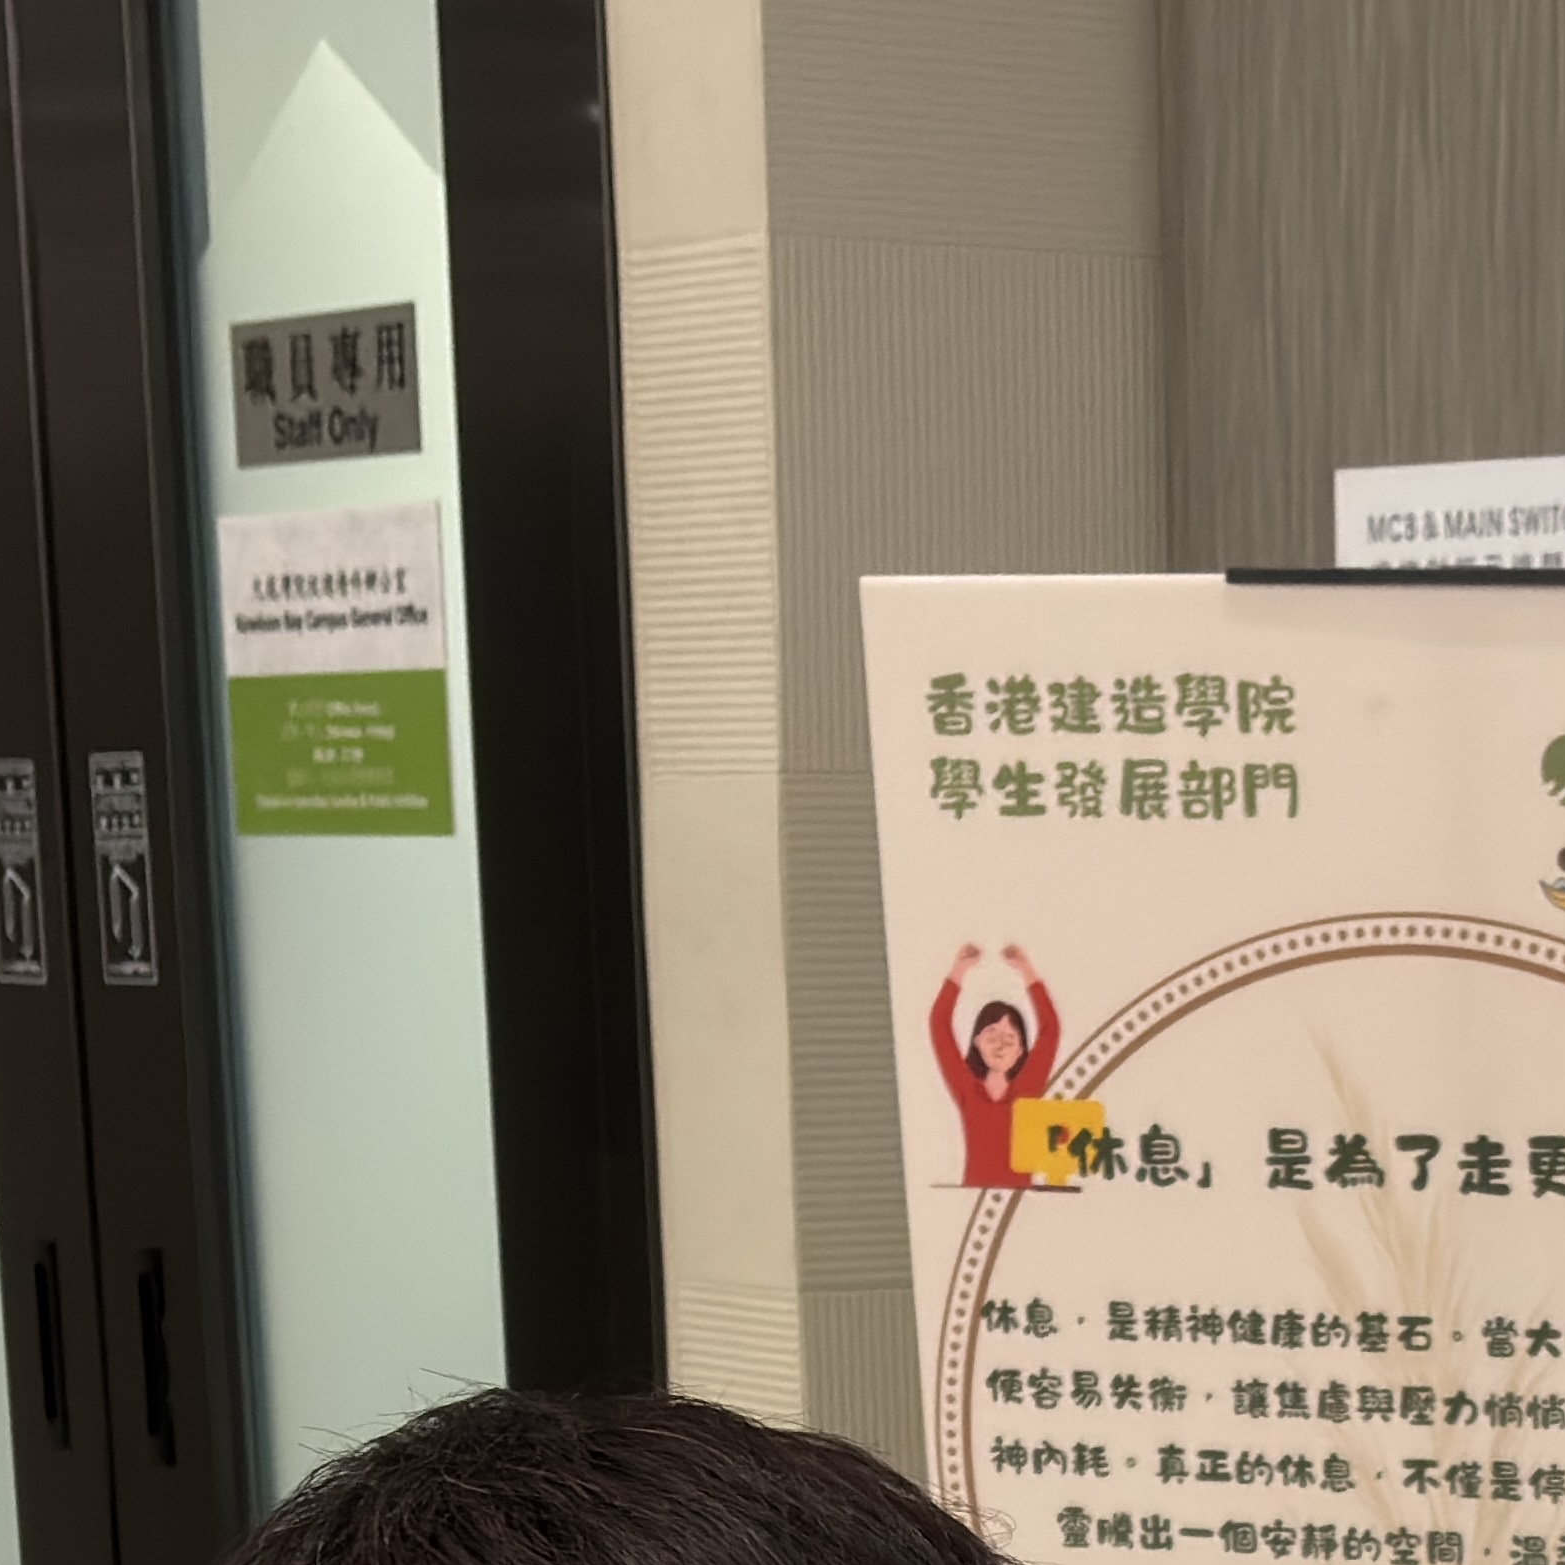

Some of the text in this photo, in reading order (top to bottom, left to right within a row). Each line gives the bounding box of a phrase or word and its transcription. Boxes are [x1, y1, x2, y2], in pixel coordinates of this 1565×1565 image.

[243, 322, 407, 406] 職員專用
[273, 406, 380, 453] Staff Only
[1367, 511, 1417, 543] MCB
[1443, 507, 1503, 539] MAIN
[925, 672, 1298, 738] 香港建造學院
[928, 757, 1301, 821] 學生發展部門
